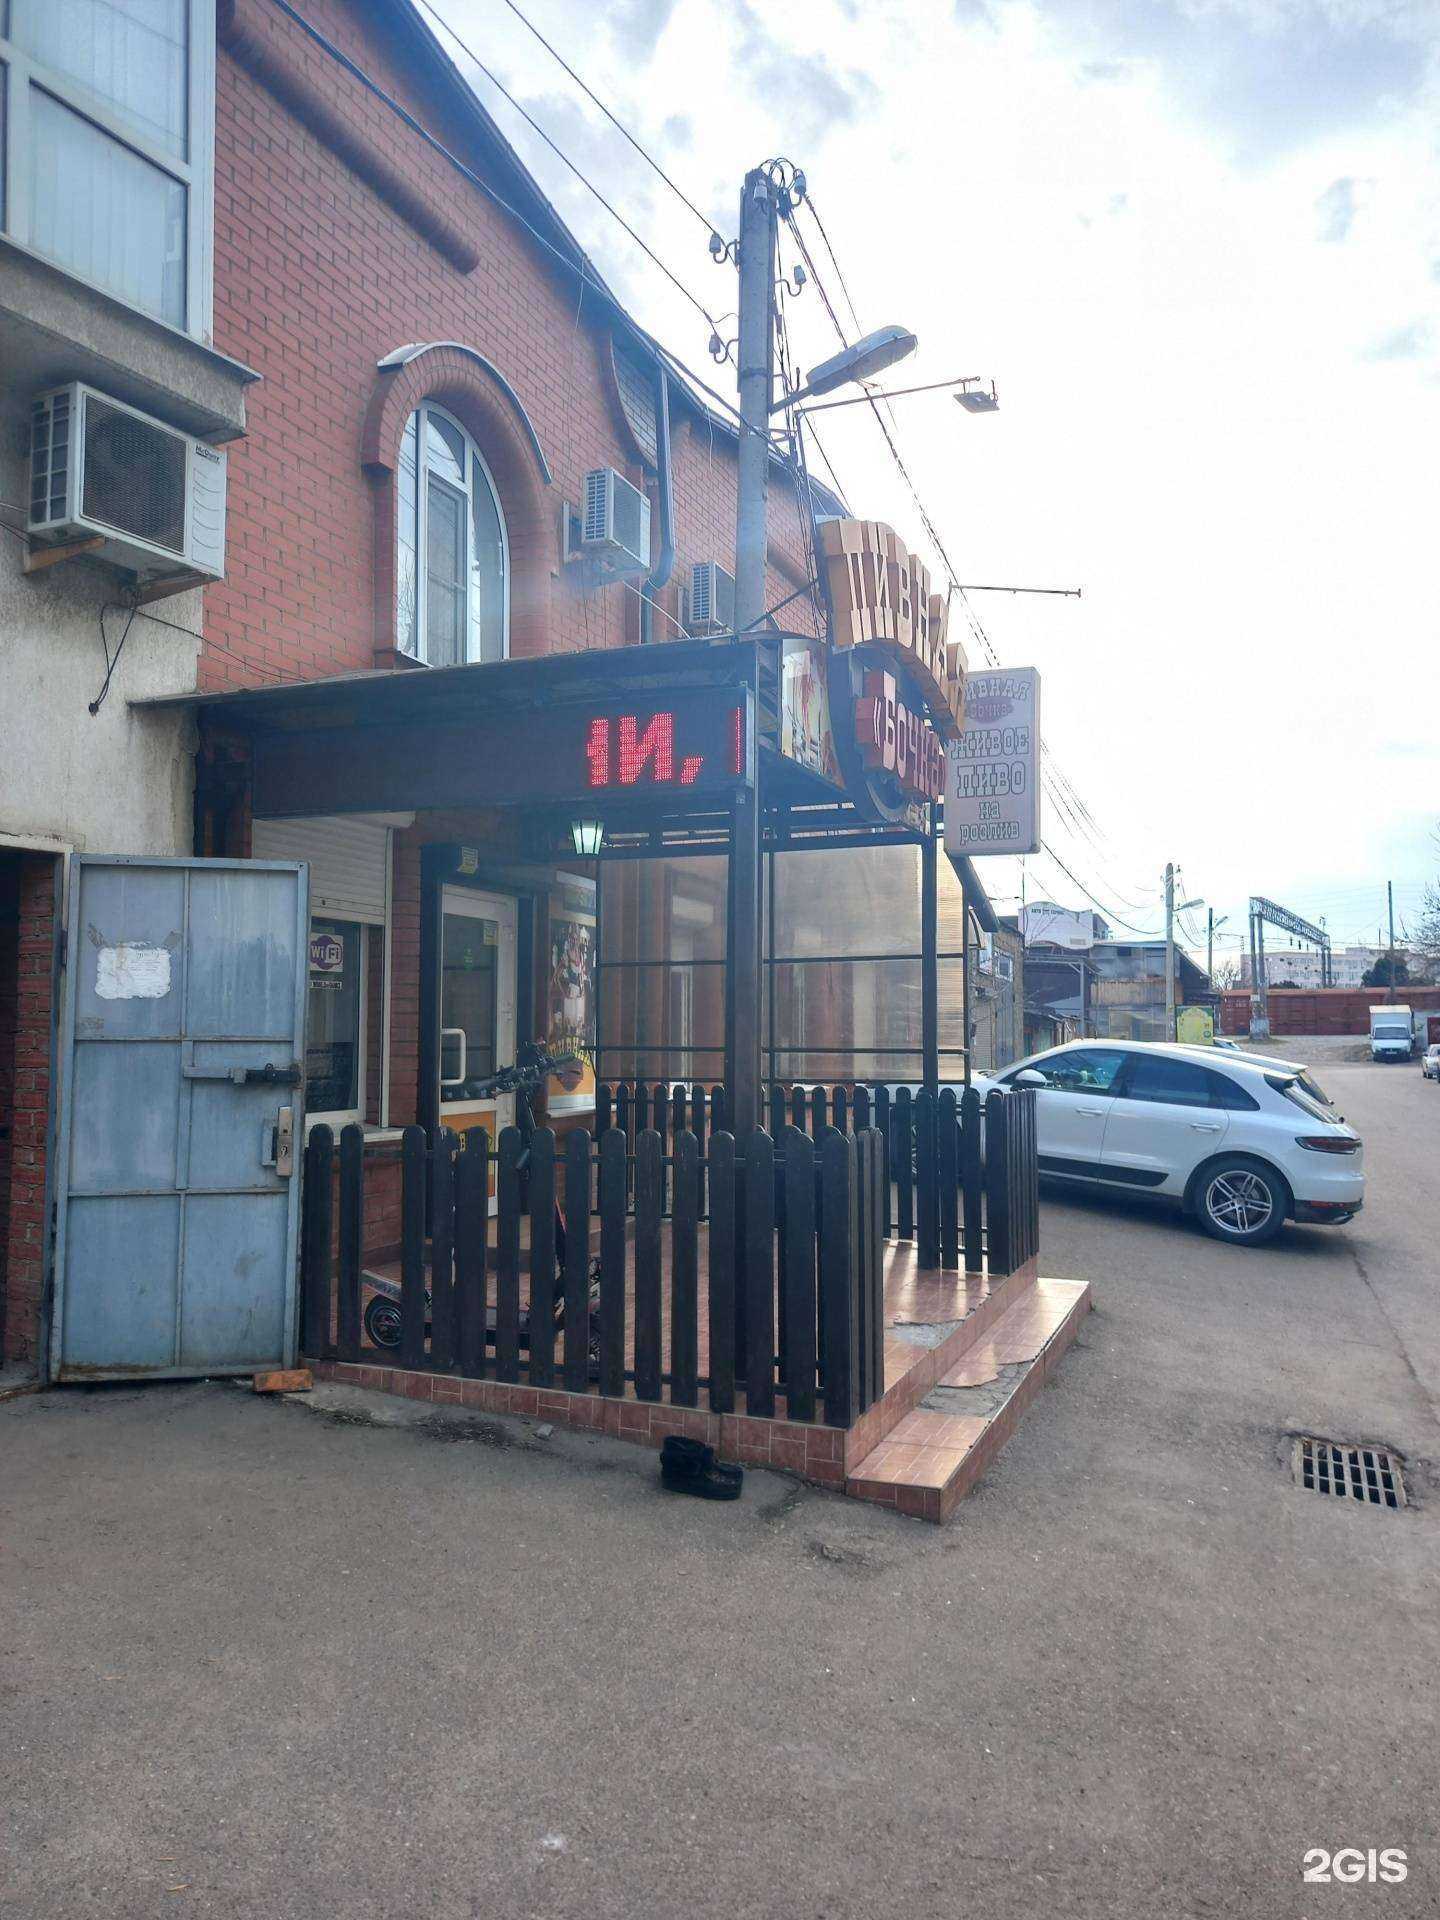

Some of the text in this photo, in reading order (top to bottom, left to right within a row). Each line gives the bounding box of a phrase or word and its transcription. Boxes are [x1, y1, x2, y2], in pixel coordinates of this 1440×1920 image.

[839, 519, 969, 739] ПИВНАЯ
[965, 678, 1030, 701] ИВНАЯ
[951, 727, 1029, 759] ЖИВОЕ
[957, 761, 1026, 798] ПИВО
[979, 801, 1000, 820] на
